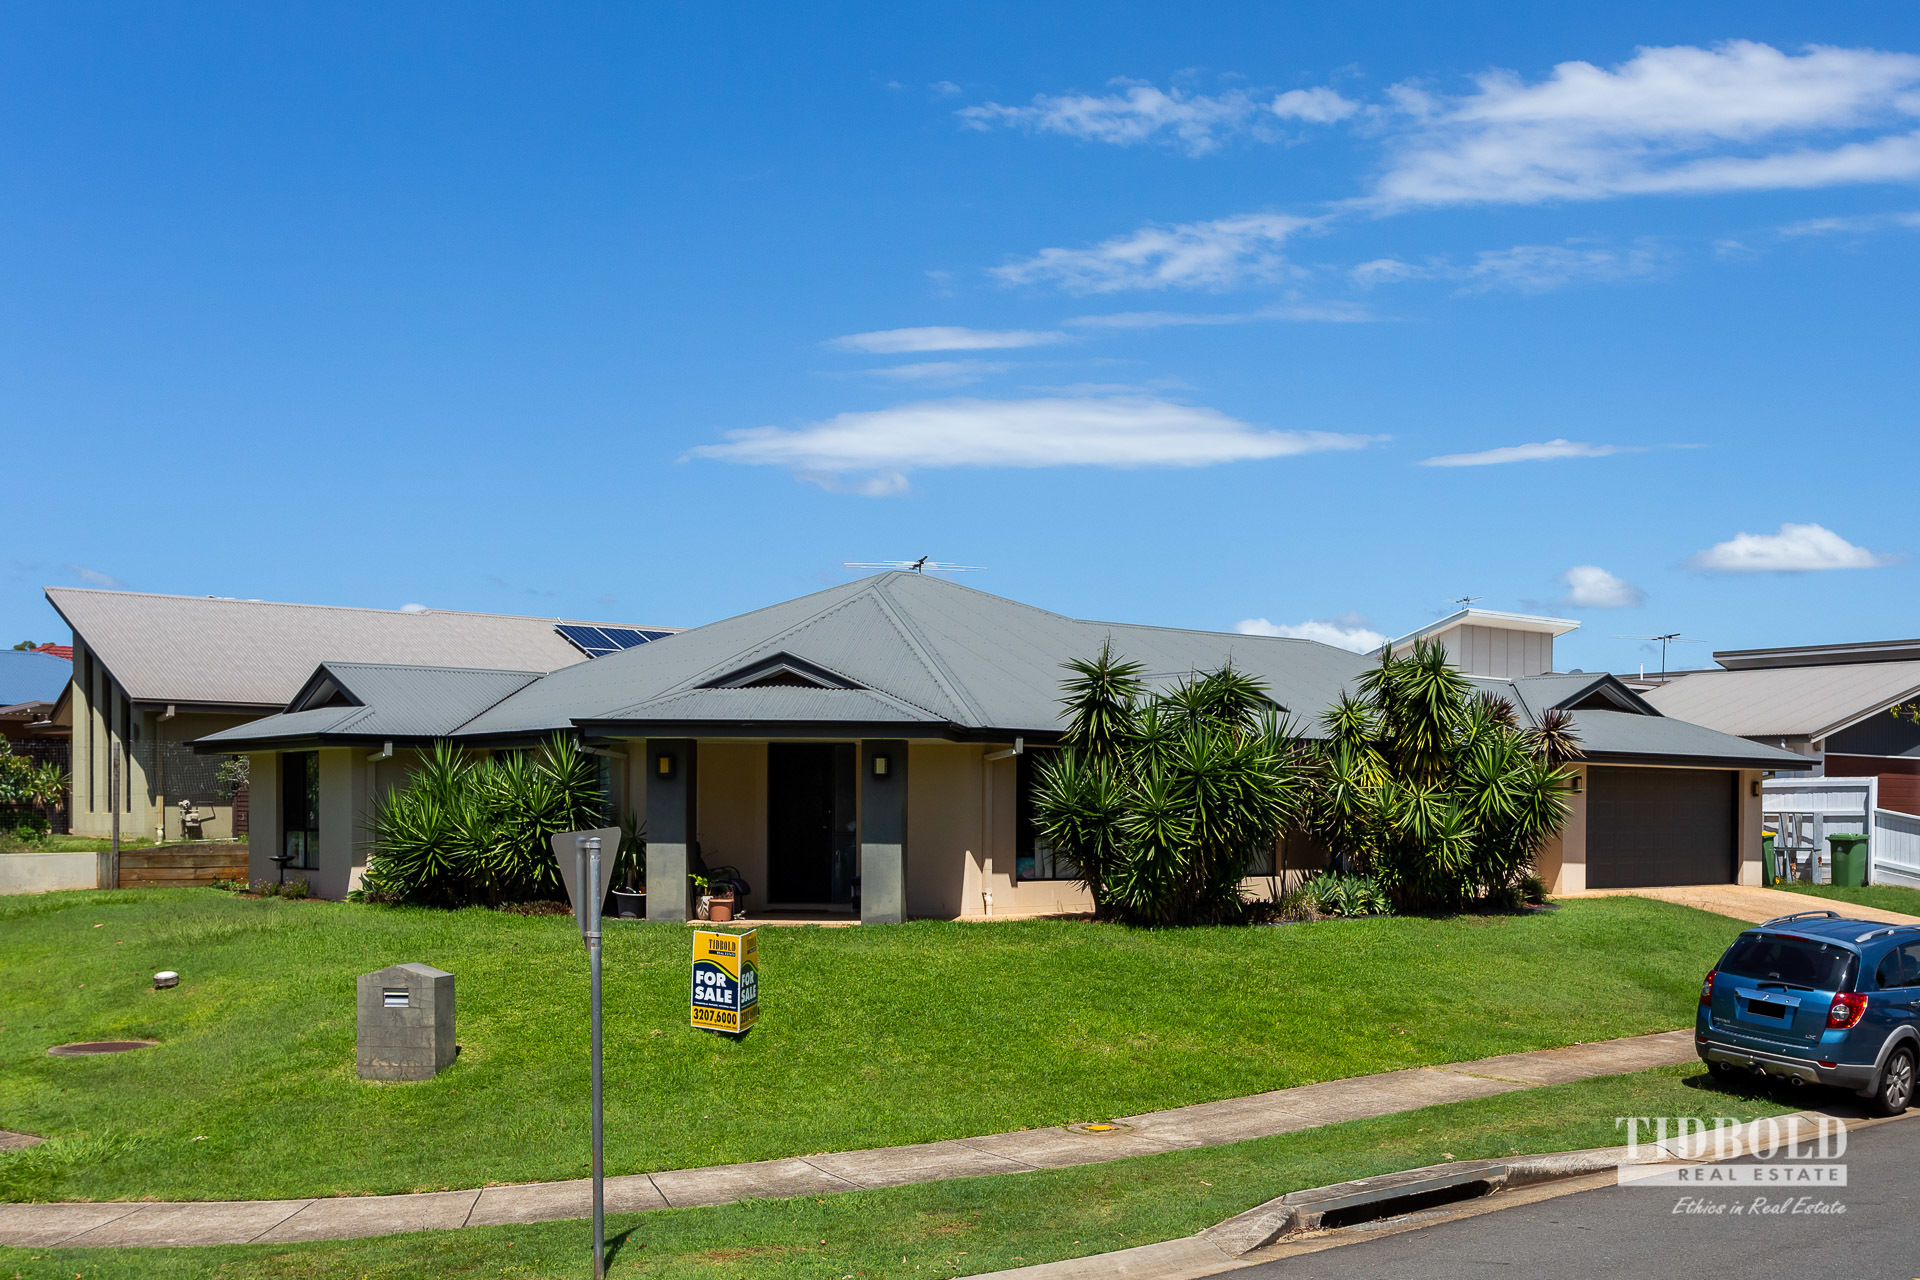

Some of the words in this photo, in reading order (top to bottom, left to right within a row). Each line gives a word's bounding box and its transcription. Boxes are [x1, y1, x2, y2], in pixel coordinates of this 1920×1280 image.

[709, 939, 736, 951] TIDBOLD
[695, 970, 726, 987] FOR
[741, 970, 755, 988] FOR
[695, 986, 733, 1004] SALE
[741, 984, 757, 1004] SALE
[693, 1009, 737, 1025] 3207.6000
